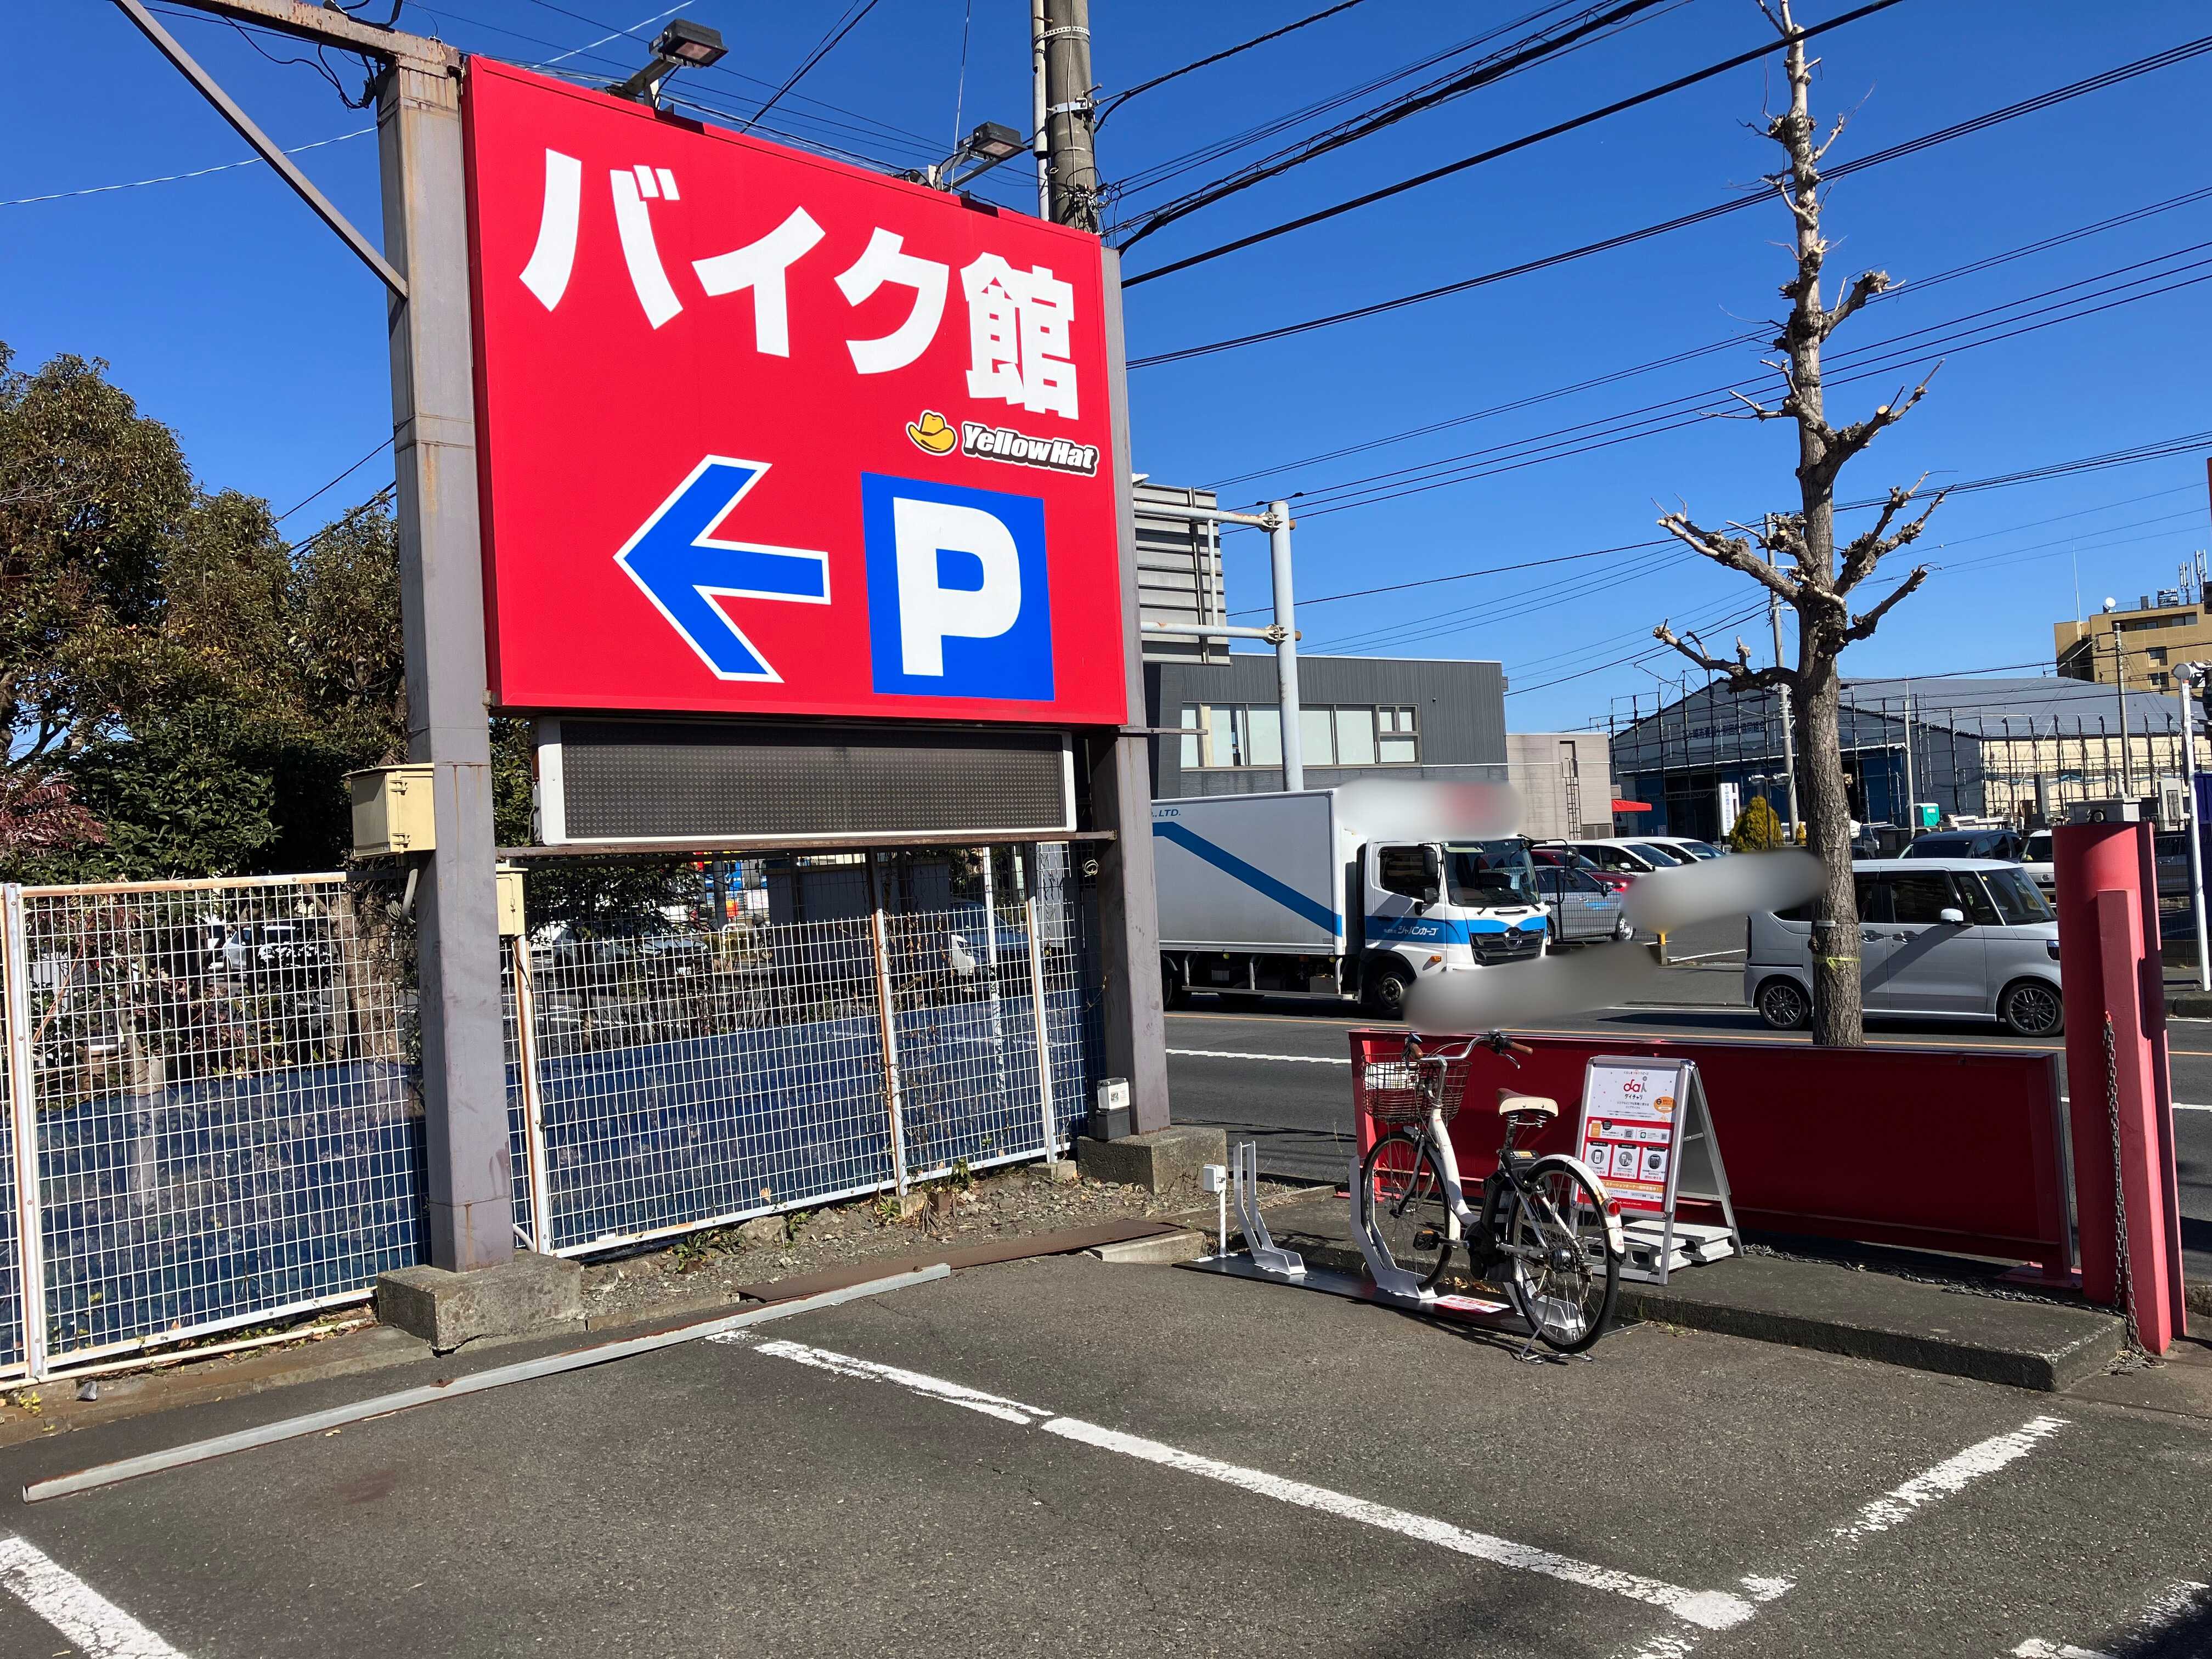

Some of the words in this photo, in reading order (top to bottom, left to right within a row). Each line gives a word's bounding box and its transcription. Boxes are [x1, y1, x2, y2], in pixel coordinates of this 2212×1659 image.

[520, 148, 1079, 420] バイク館
[893, 497, 1022, 677] P
